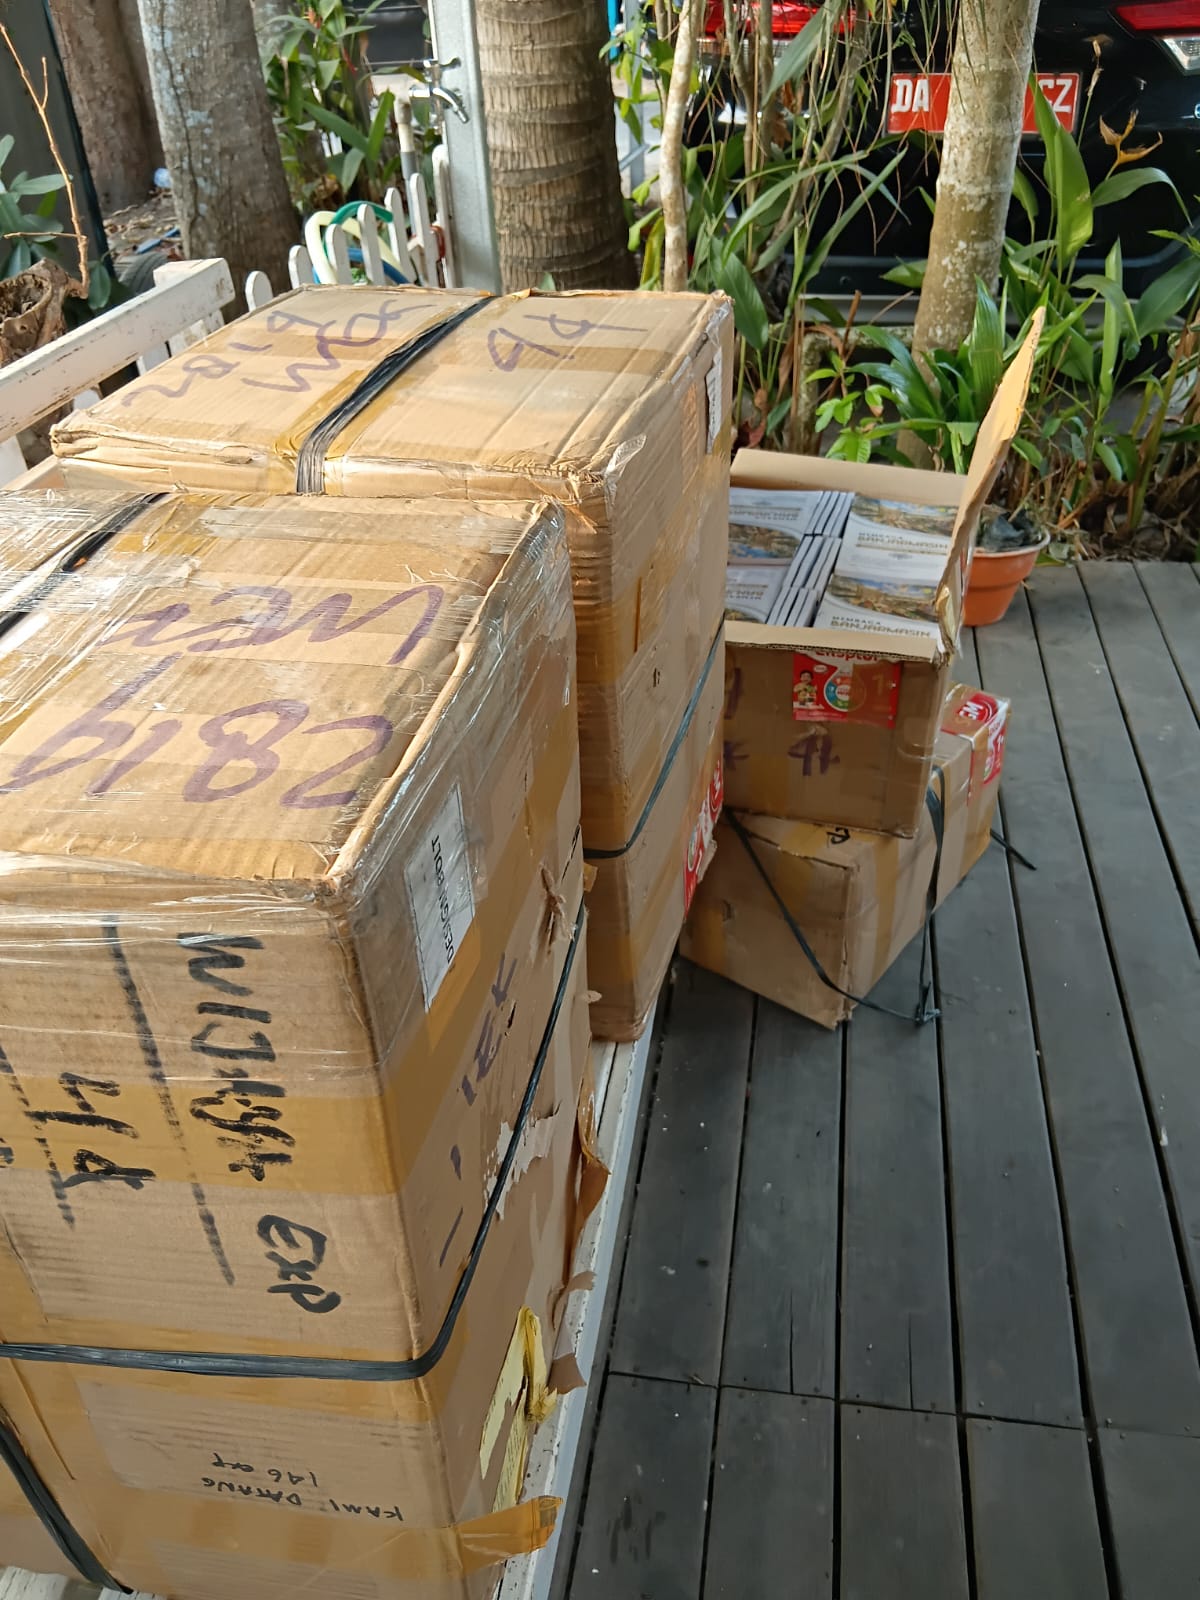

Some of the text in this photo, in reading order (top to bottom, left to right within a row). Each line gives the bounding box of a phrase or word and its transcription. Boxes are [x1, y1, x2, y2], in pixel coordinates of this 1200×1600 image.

[891, 79, 929, 112] DA
[830, 620, 931, 638] BANJARMASIN
[431, 835, 445, 887] BOLT
[201, 1477, 404, 1522] KAMI DATANG
